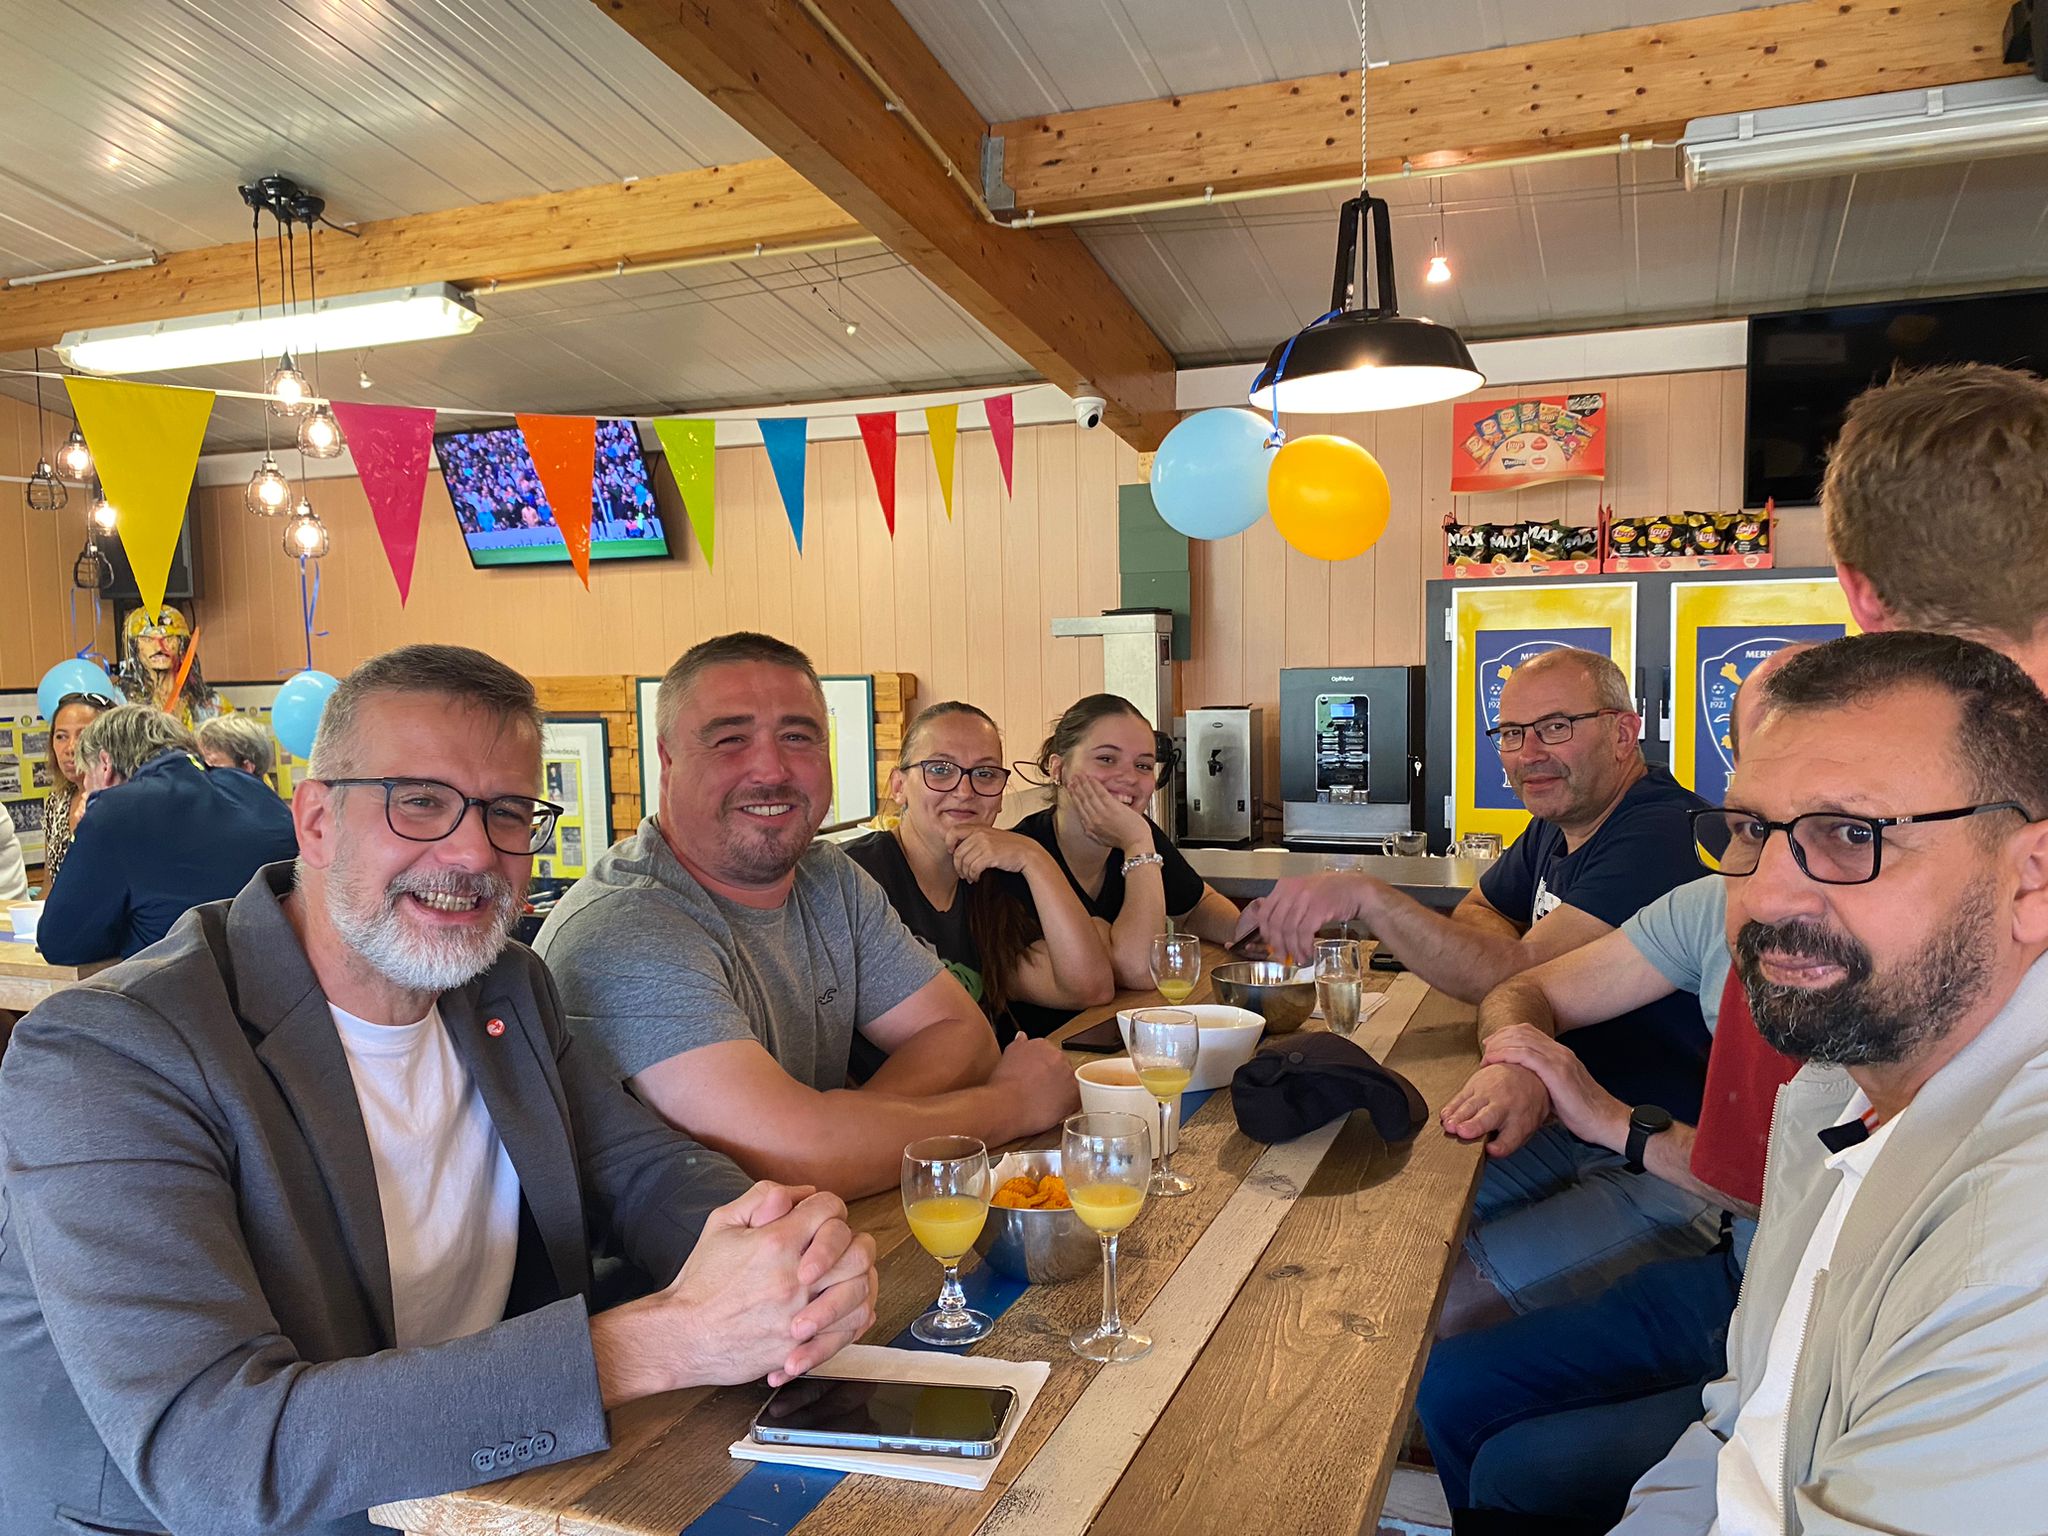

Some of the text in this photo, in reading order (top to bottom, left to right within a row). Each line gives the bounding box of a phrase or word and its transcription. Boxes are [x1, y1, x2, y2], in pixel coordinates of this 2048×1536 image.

[1448, 531, 1484, 547] MAX
[1528, 525, 1563, 545] MAX
[1488, 701, 1501, 709] 192
[1710, 701, 1727, 709] 1921
